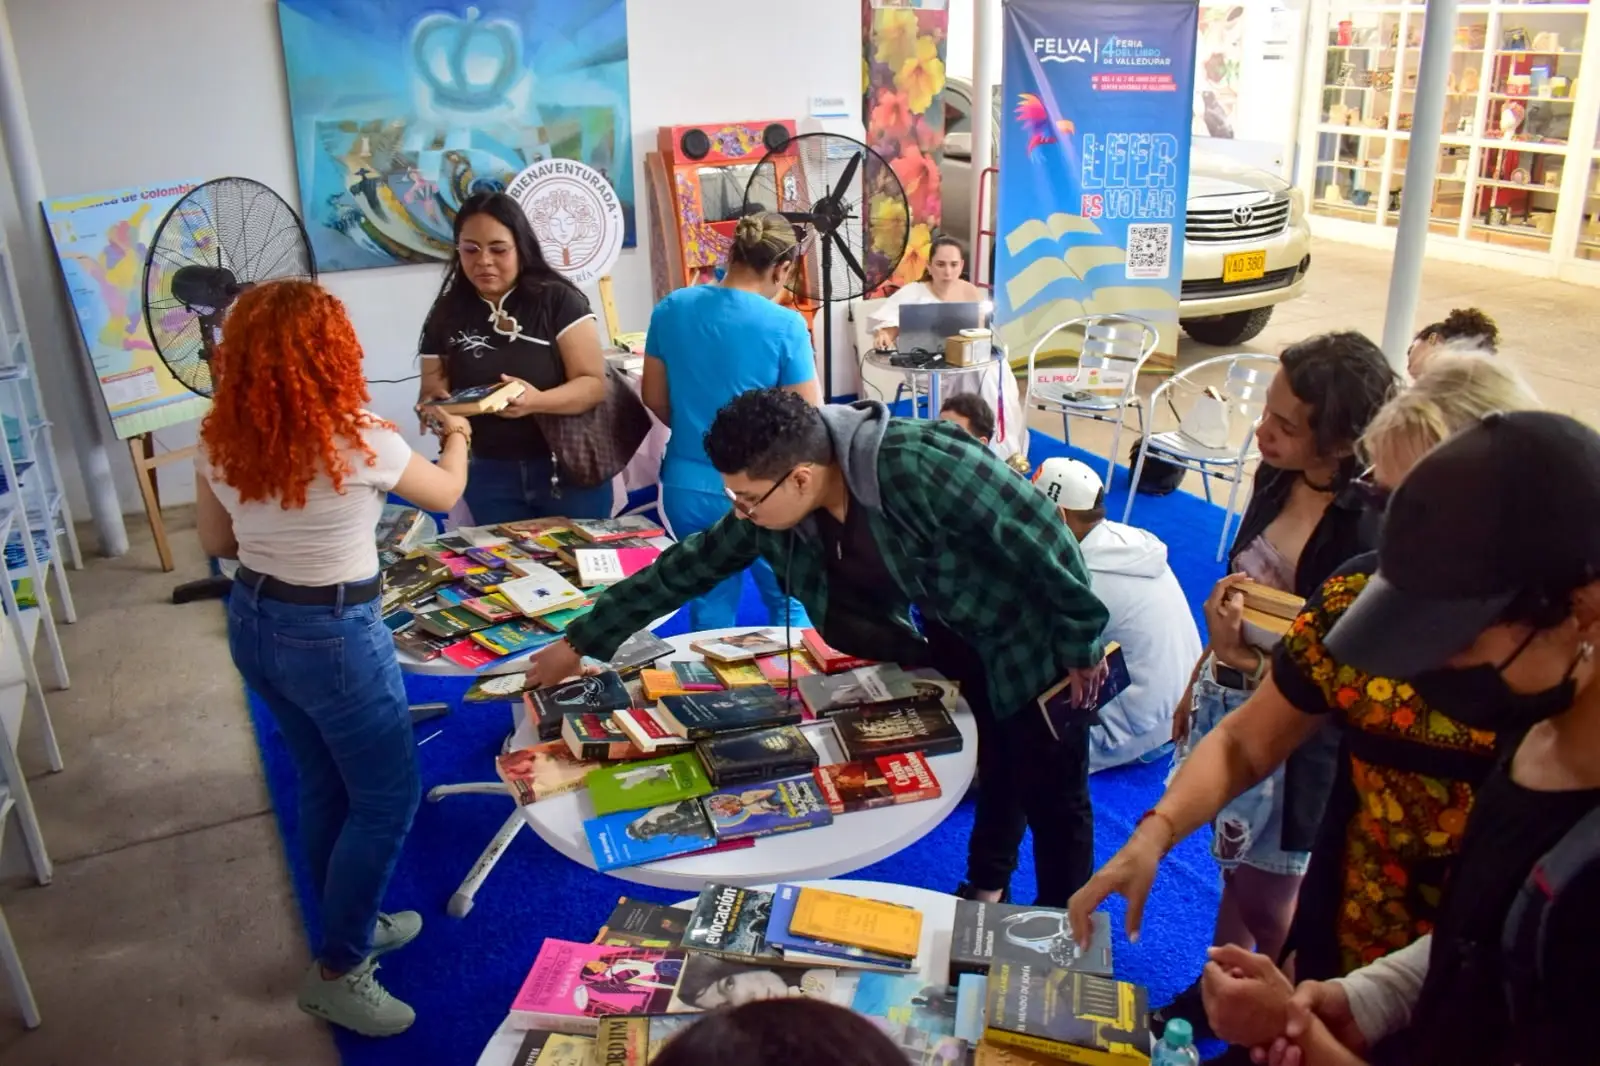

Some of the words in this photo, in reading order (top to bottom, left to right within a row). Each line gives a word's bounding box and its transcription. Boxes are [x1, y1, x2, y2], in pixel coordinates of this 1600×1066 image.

[1034, 38, 1092, 54] FELVA
[1115, 39, 1143, 48] FERIA
[1115, 48, 1132, 57] DEL
[1115, 57, 1171, 65] VALLEDUPAR
[1081, 132, 1179, 189] LEER
[510, 162, 617, 213] BIENAVENTURADA
[1081, 193, 1104, 219] ES
[1104, 188, 1177, 219] VOLAR
[705, 886, 737, 945] evocación
